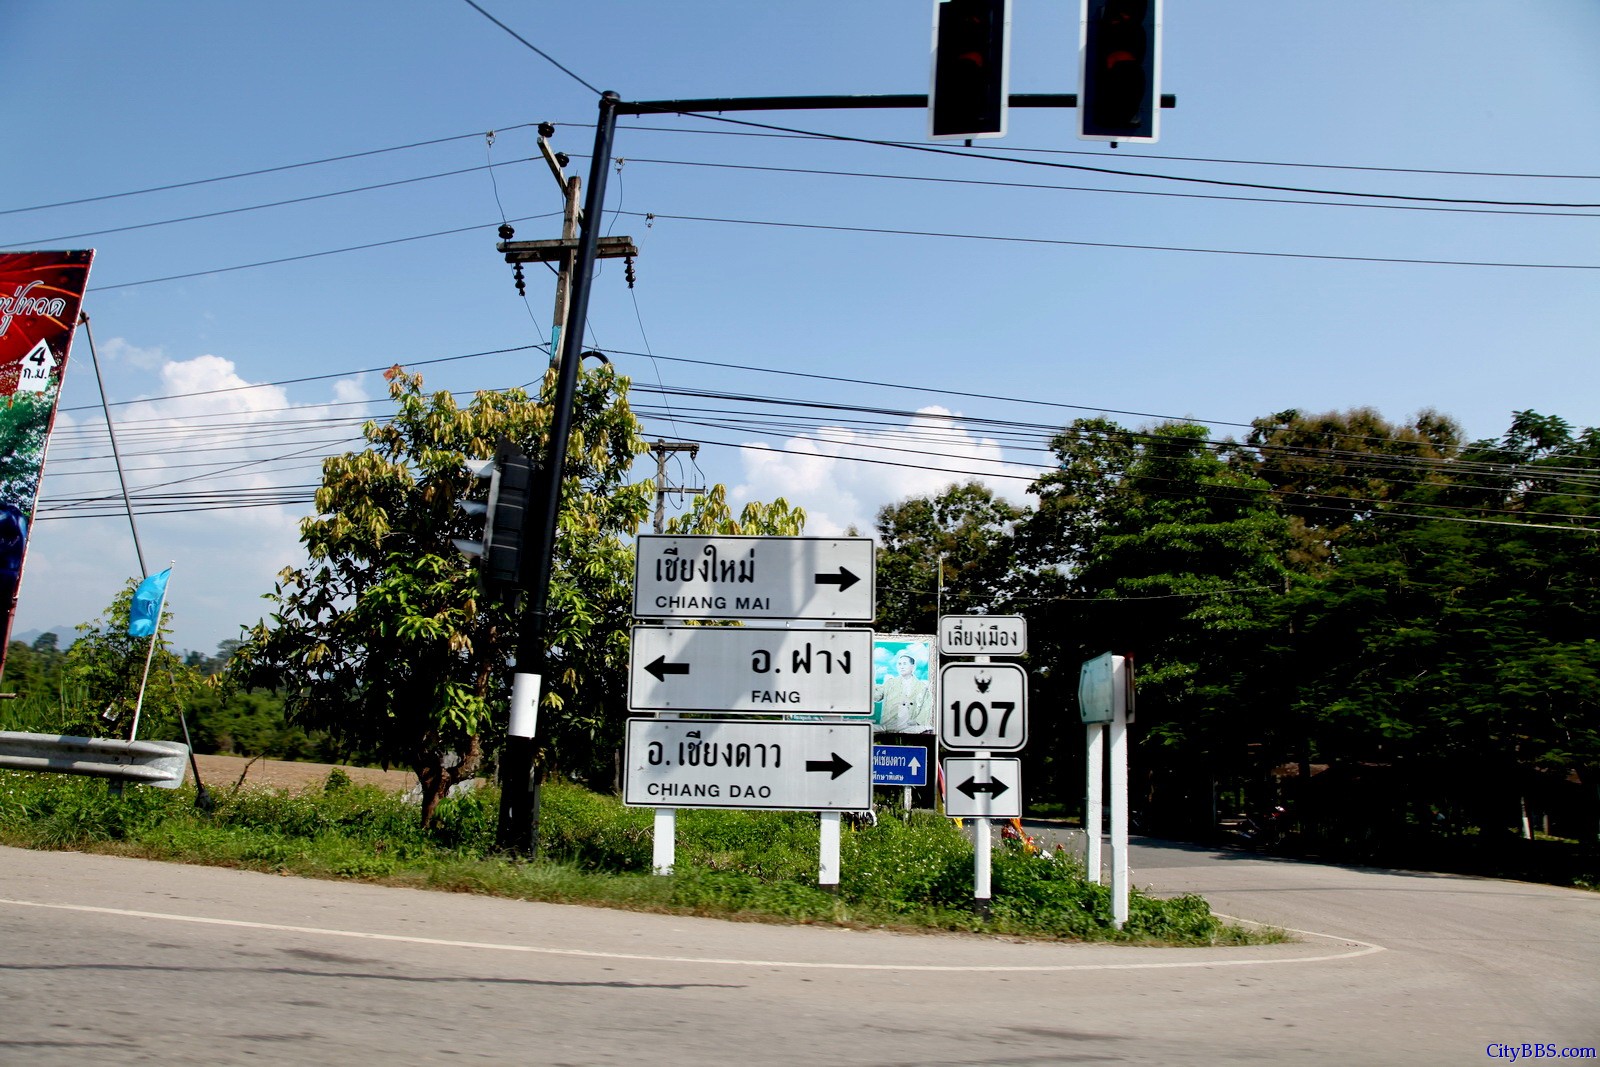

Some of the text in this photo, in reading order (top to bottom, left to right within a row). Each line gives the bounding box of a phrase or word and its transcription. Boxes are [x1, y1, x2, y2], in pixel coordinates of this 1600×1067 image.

[29, 346, 46, 366] 4
[23, 367, 47, 379] ก.ม.
[656, 545, 755, 583] เชียงใหม่
[655, 596, 770, 610] CHIANG MAI
[948, 619, 1017, 646] เลี่ยงเมือง
[751, 691, 800, 703] FANG
[950, 701, 1015, 738] 107
[647, 783, 771, 798] CHIANG DAO
